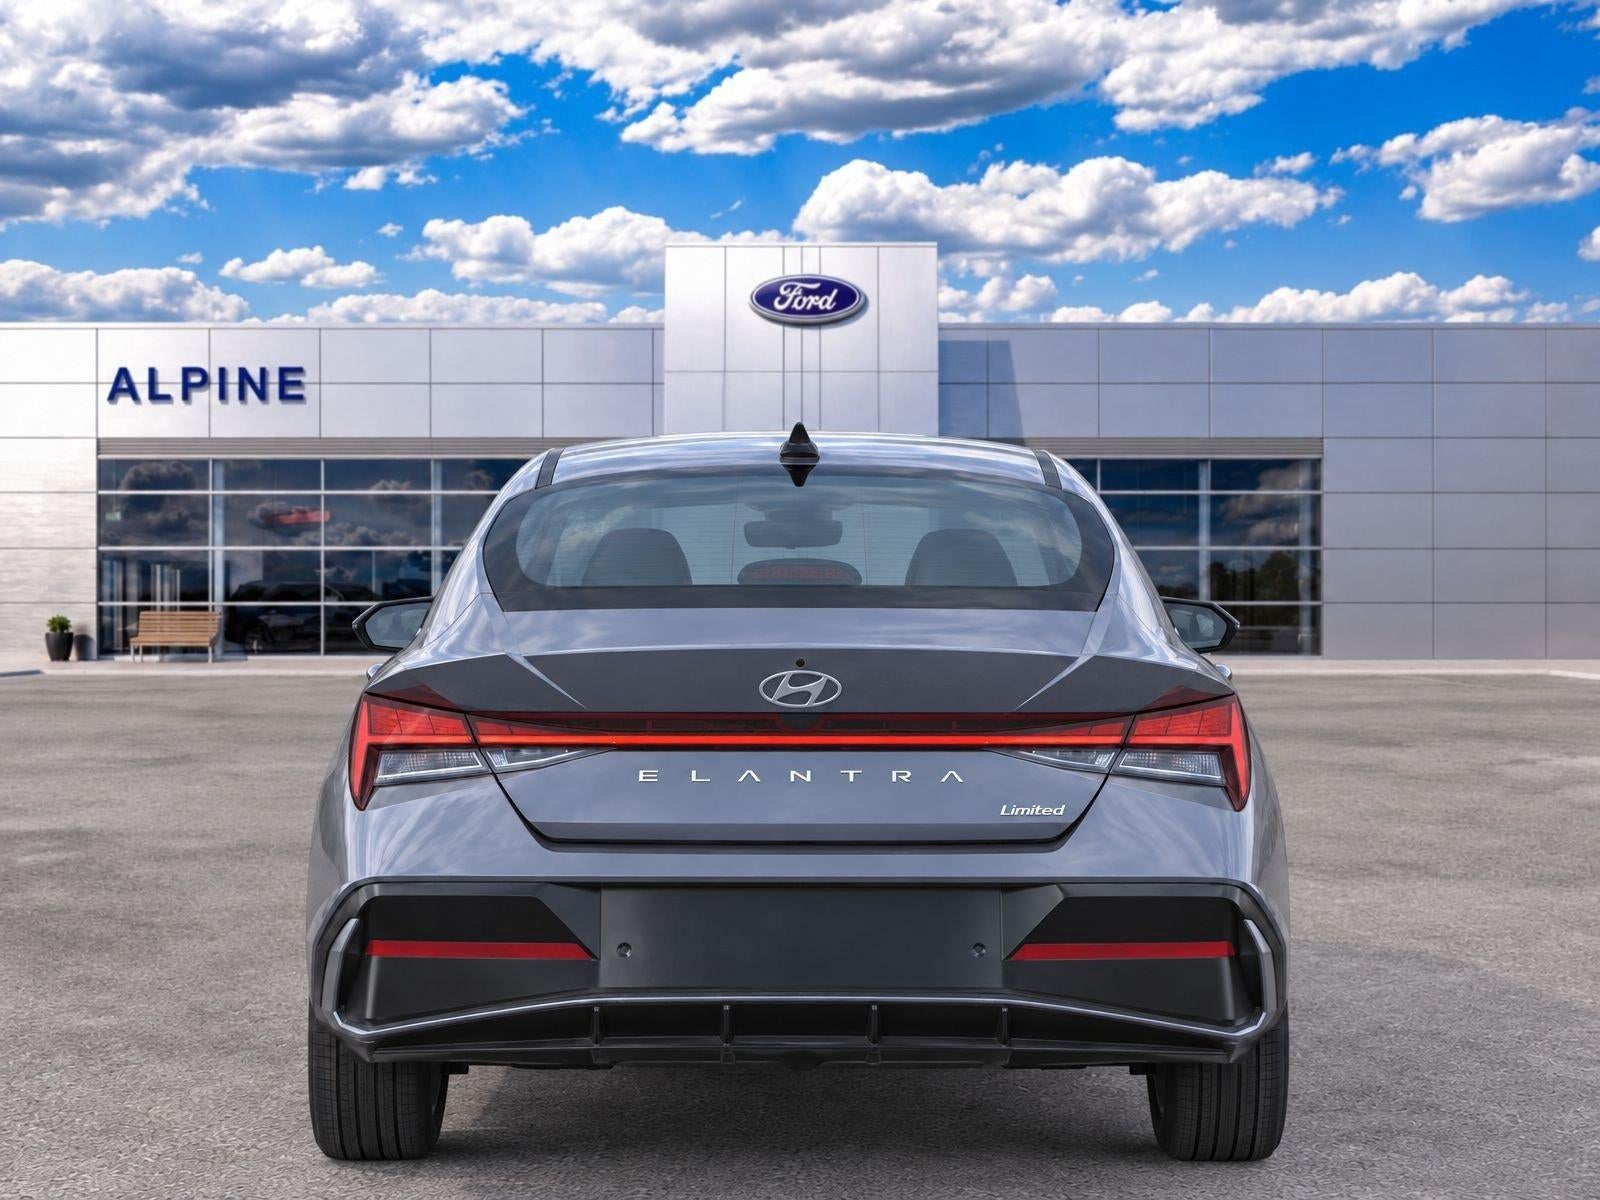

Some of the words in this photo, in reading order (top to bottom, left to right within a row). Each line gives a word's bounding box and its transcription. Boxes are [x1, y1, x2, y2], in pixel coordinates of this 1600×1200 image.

[773, 280, 838, 311] Ford
[106, 366, 305, 403] ALPINE
[637, 769, 965, 783] ELANTRA
[999, 804, 1066, 816] Limited
